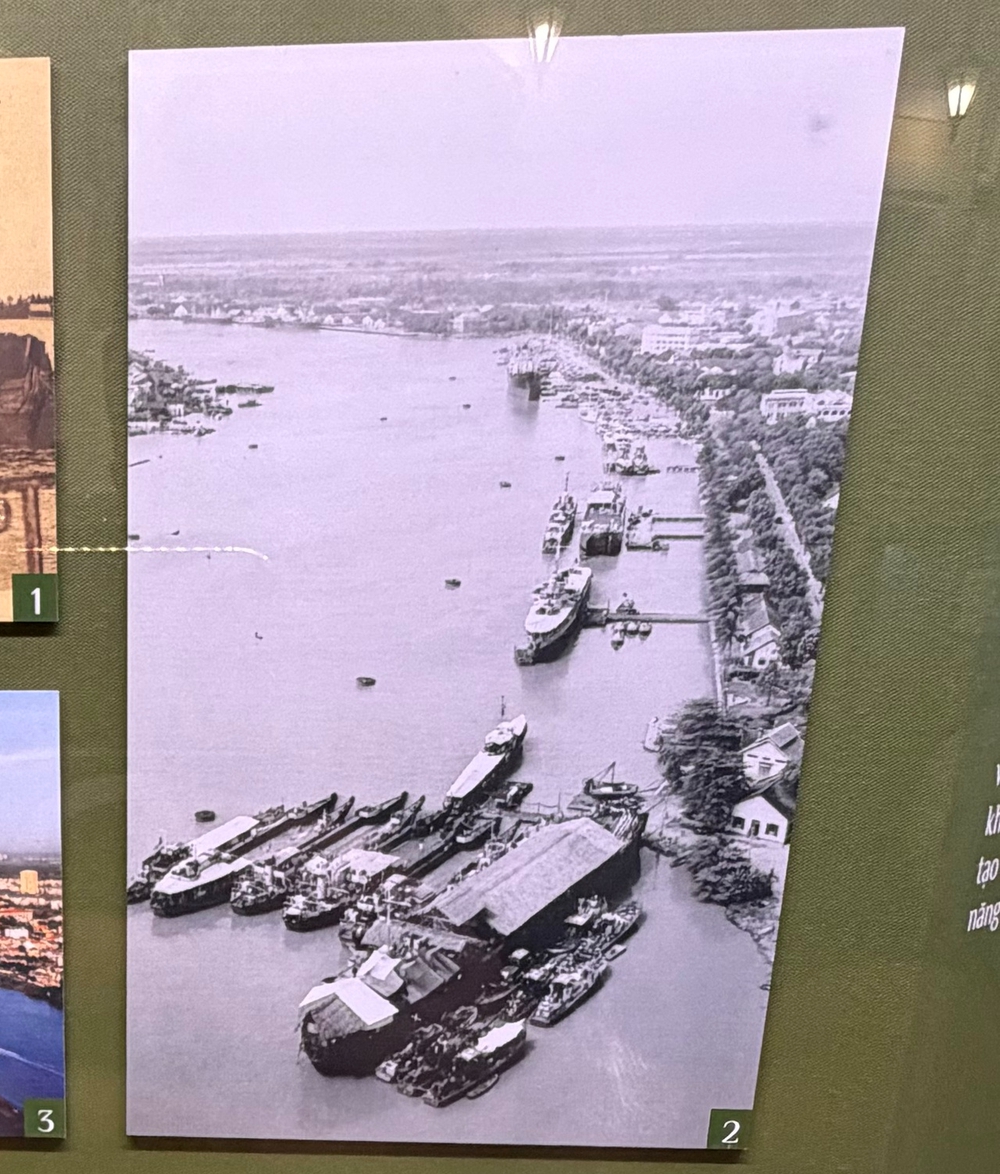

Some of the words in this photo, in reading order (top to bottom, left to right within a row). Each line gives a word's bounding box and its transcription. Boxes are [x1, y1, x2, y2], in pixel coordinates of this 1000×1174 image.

[30, 587, 41, 616] 1
[976, 856, 1000, 889] tạo
[967, 901, 1000, 932] năng
[37, 1109, 55, 1133] 3
[721, 1119, 741, 1144] 2
